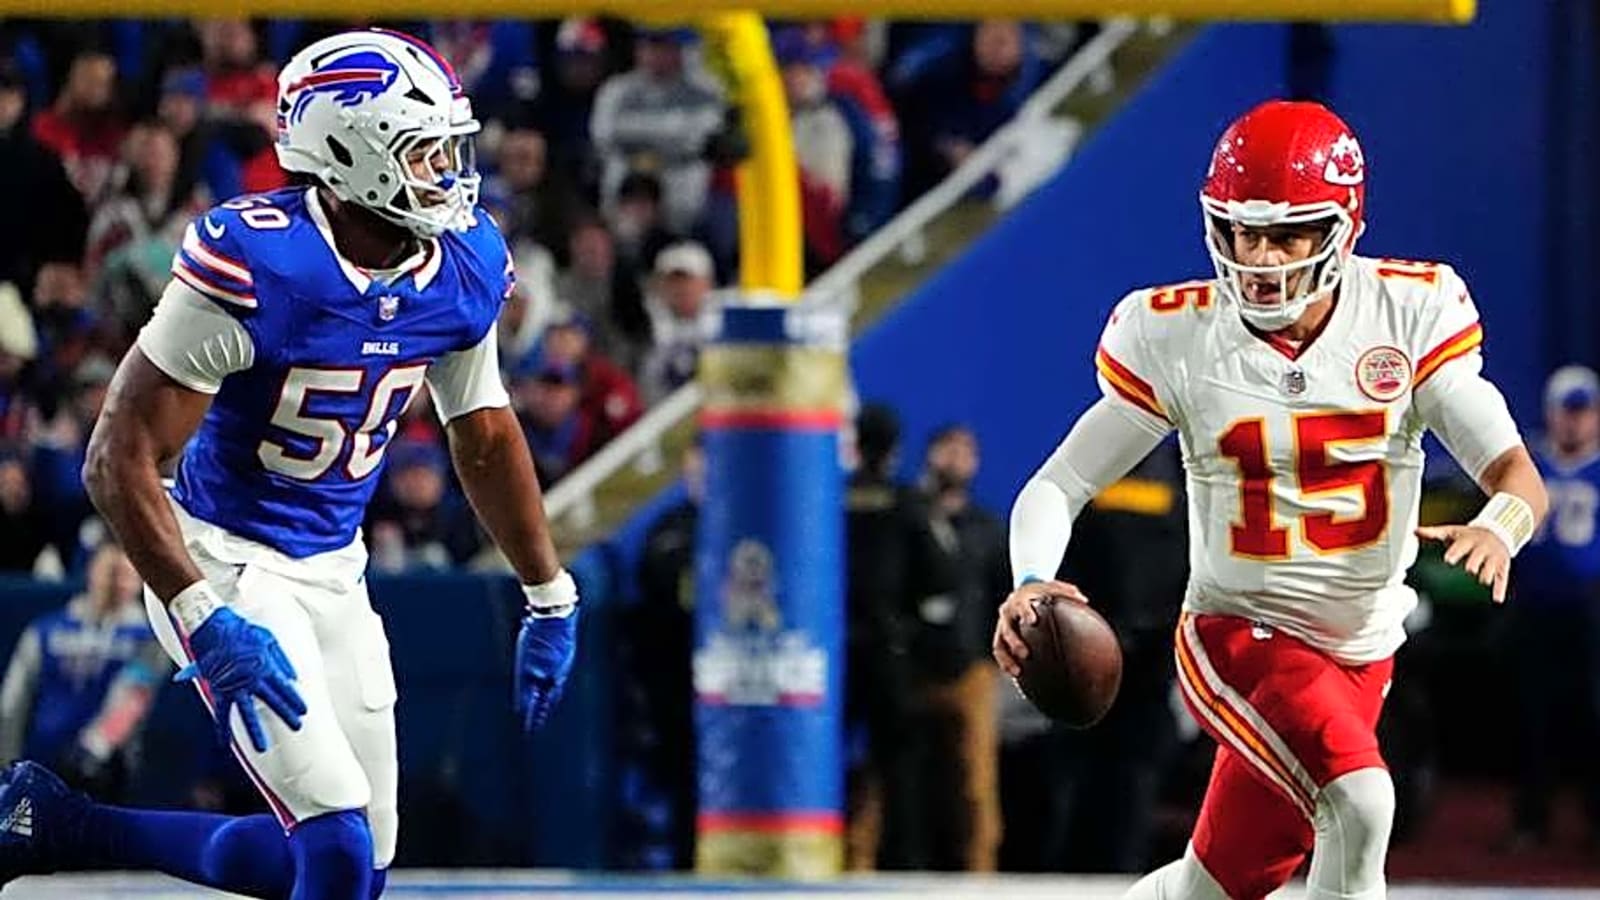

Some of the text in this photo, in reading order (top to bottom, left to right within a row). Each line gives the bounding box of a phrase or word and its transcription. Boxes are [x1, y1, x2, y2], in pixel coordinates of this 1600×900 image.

[361, 341, 399, 355] BILLS
[255, 363, 428, 482] 50
[1217, 409, 1388, 561] 15
